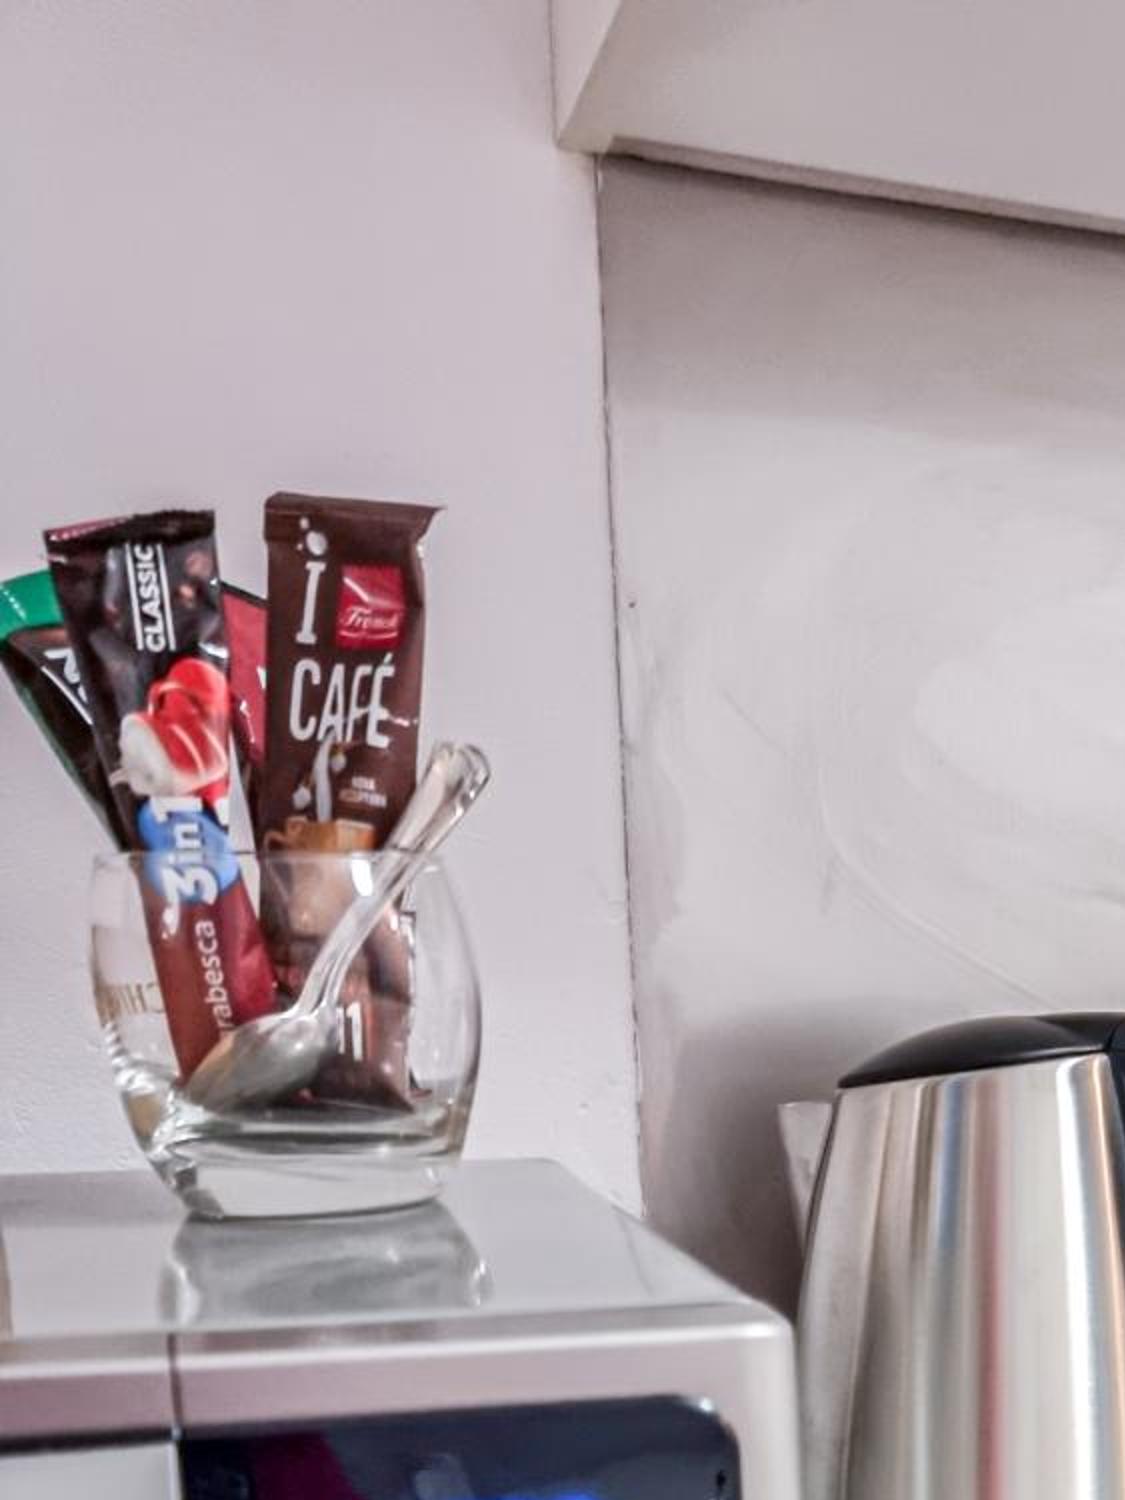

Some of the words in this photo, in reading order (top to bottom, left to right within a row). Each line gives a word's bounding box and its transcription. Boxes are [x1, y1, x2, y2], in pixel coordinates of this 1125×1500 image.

[134, 544, 166, 652] CLASSIC
[289, 652, 396, 748] CAFÉ
[195, 920, 233, 1034] rabesca
